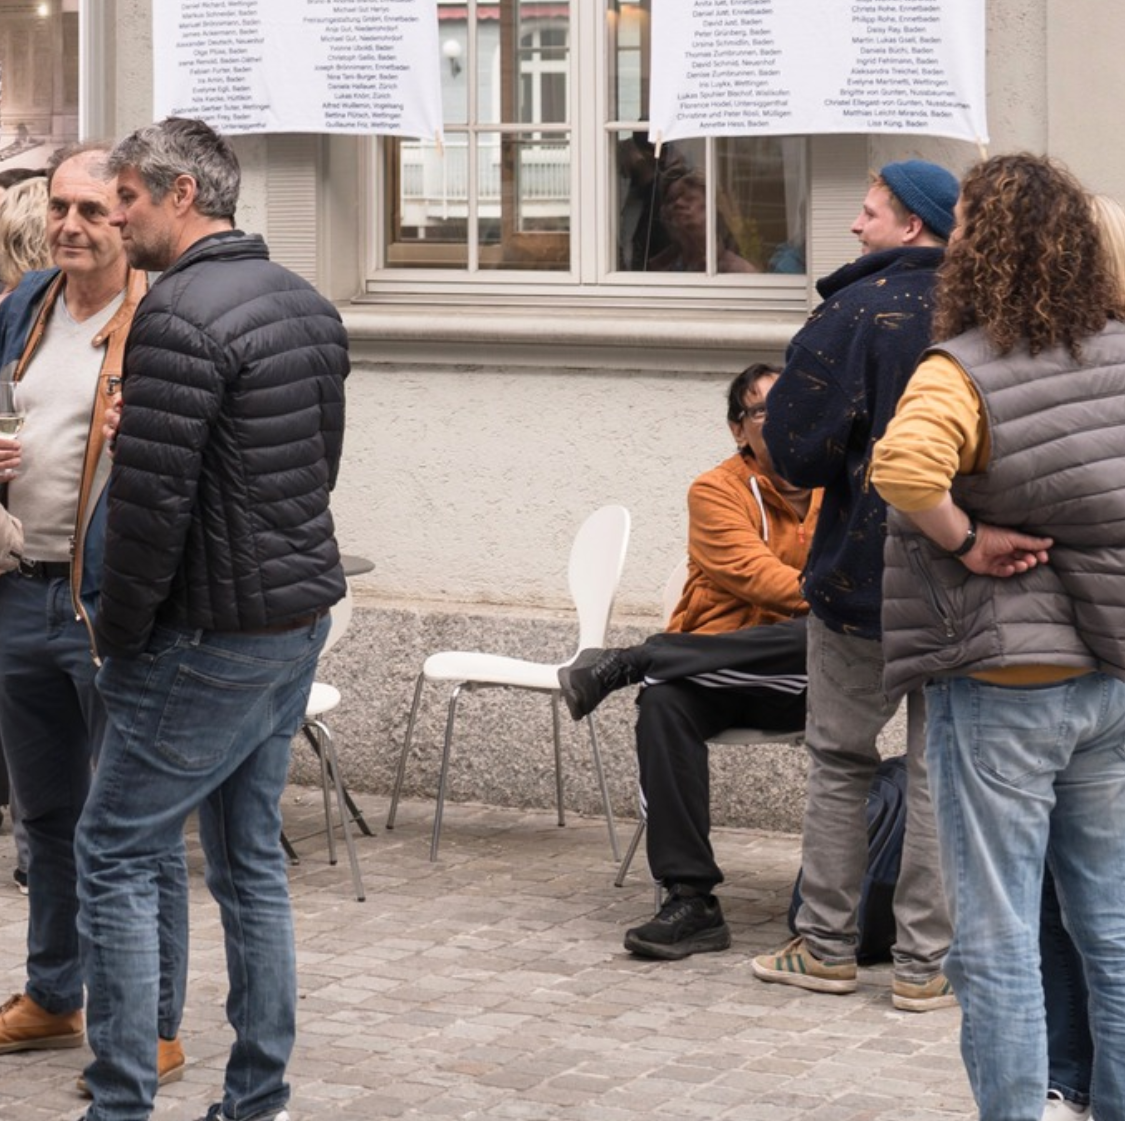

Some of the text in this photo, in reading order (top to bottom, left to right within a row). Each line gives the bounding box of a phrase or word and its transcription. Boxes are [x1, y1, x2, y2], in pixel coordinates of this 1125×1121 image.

[238, 8, 257, 16] Baden
[759, 48, 782, 56] Baden
[913, 79, 948, 87] Wettingen
